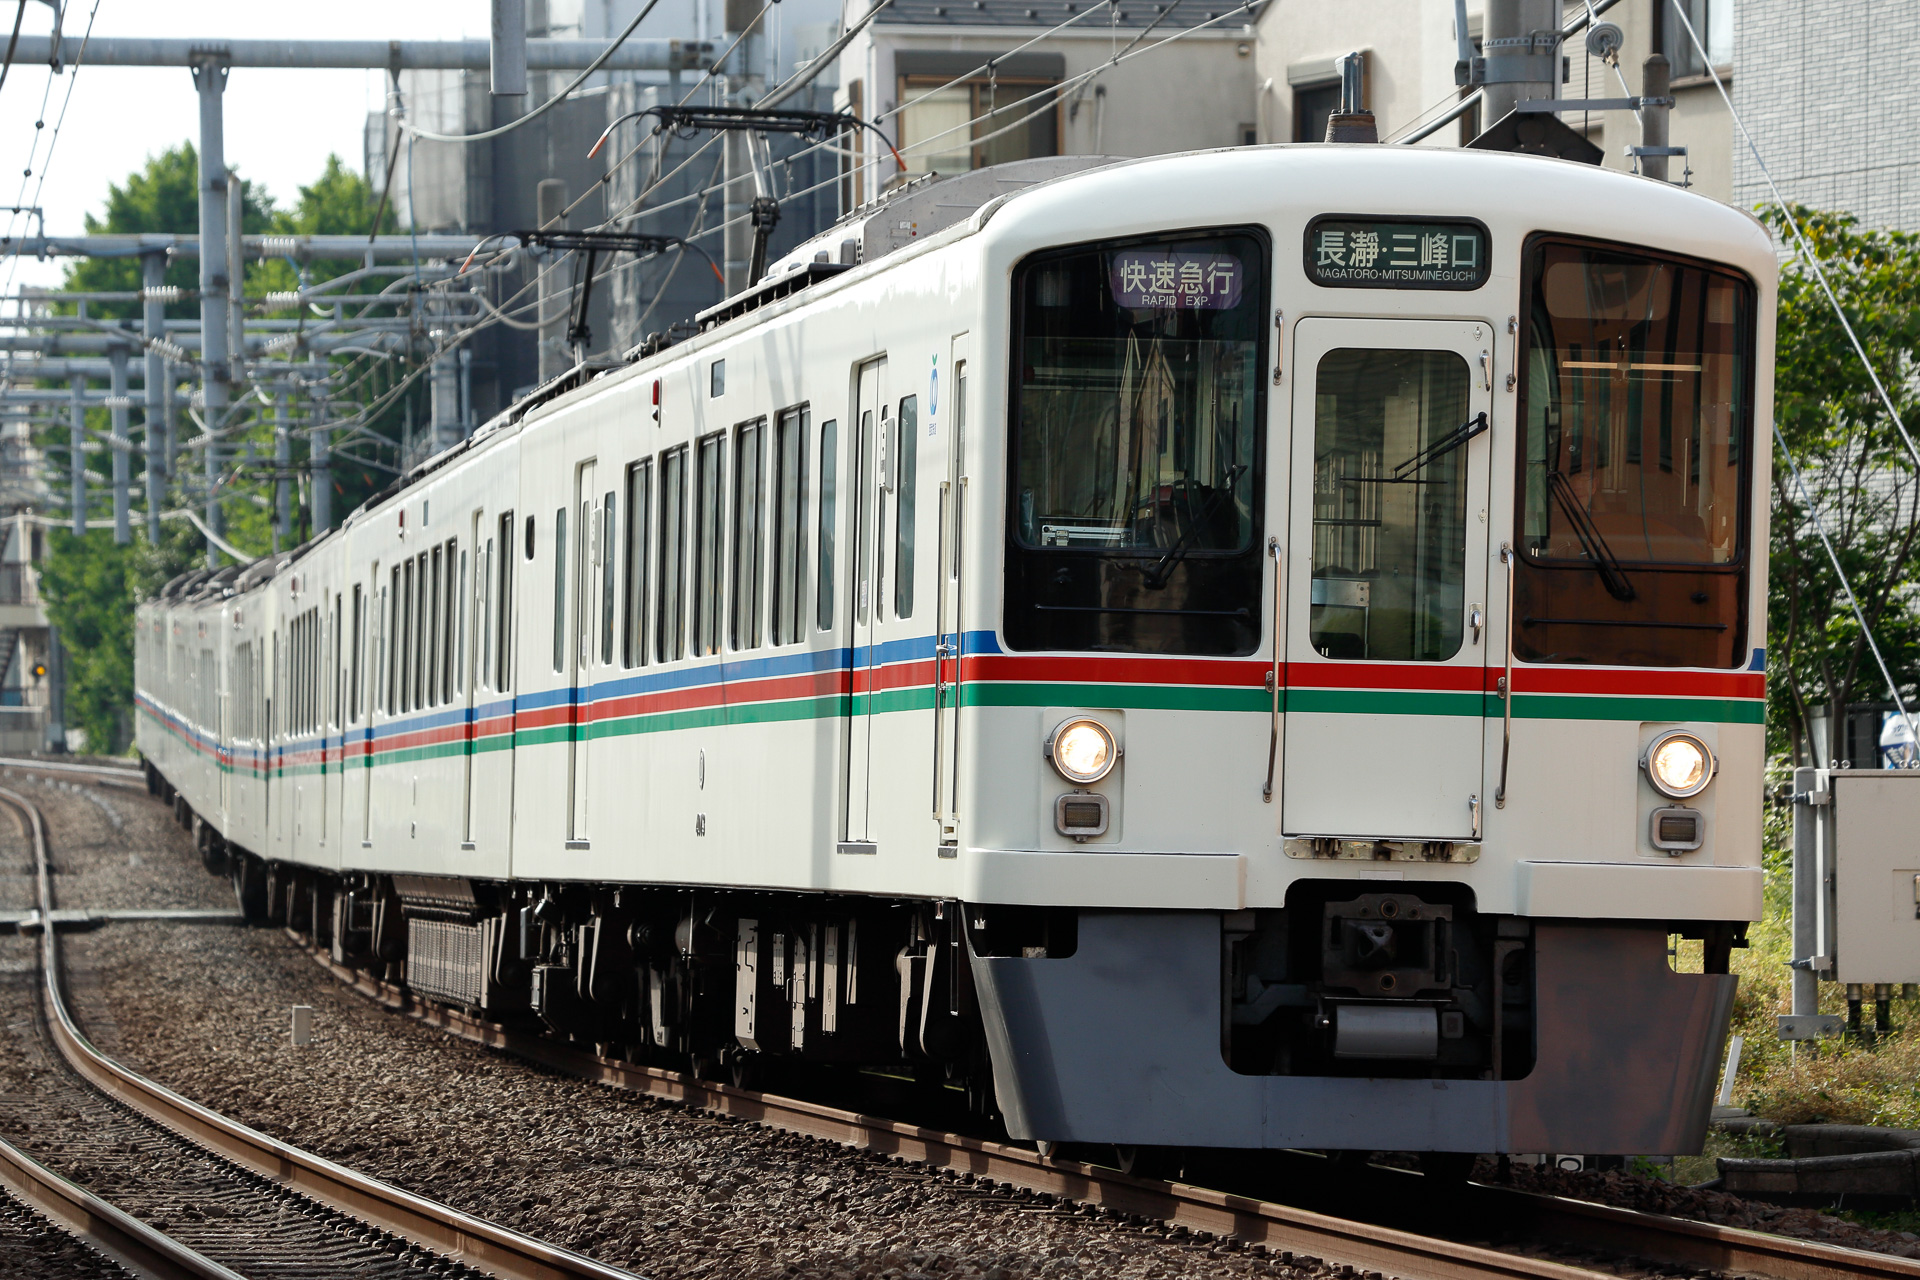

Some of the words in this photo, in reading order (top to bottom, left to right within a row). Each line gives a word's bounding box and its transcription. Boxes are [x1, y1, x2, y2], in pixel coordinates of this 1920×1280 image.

[1120, 259, 1234, 295] 快速急行
[1141, 294, 1178, 306] RAPID
[1185, 295, 1212, 307] EXP.
